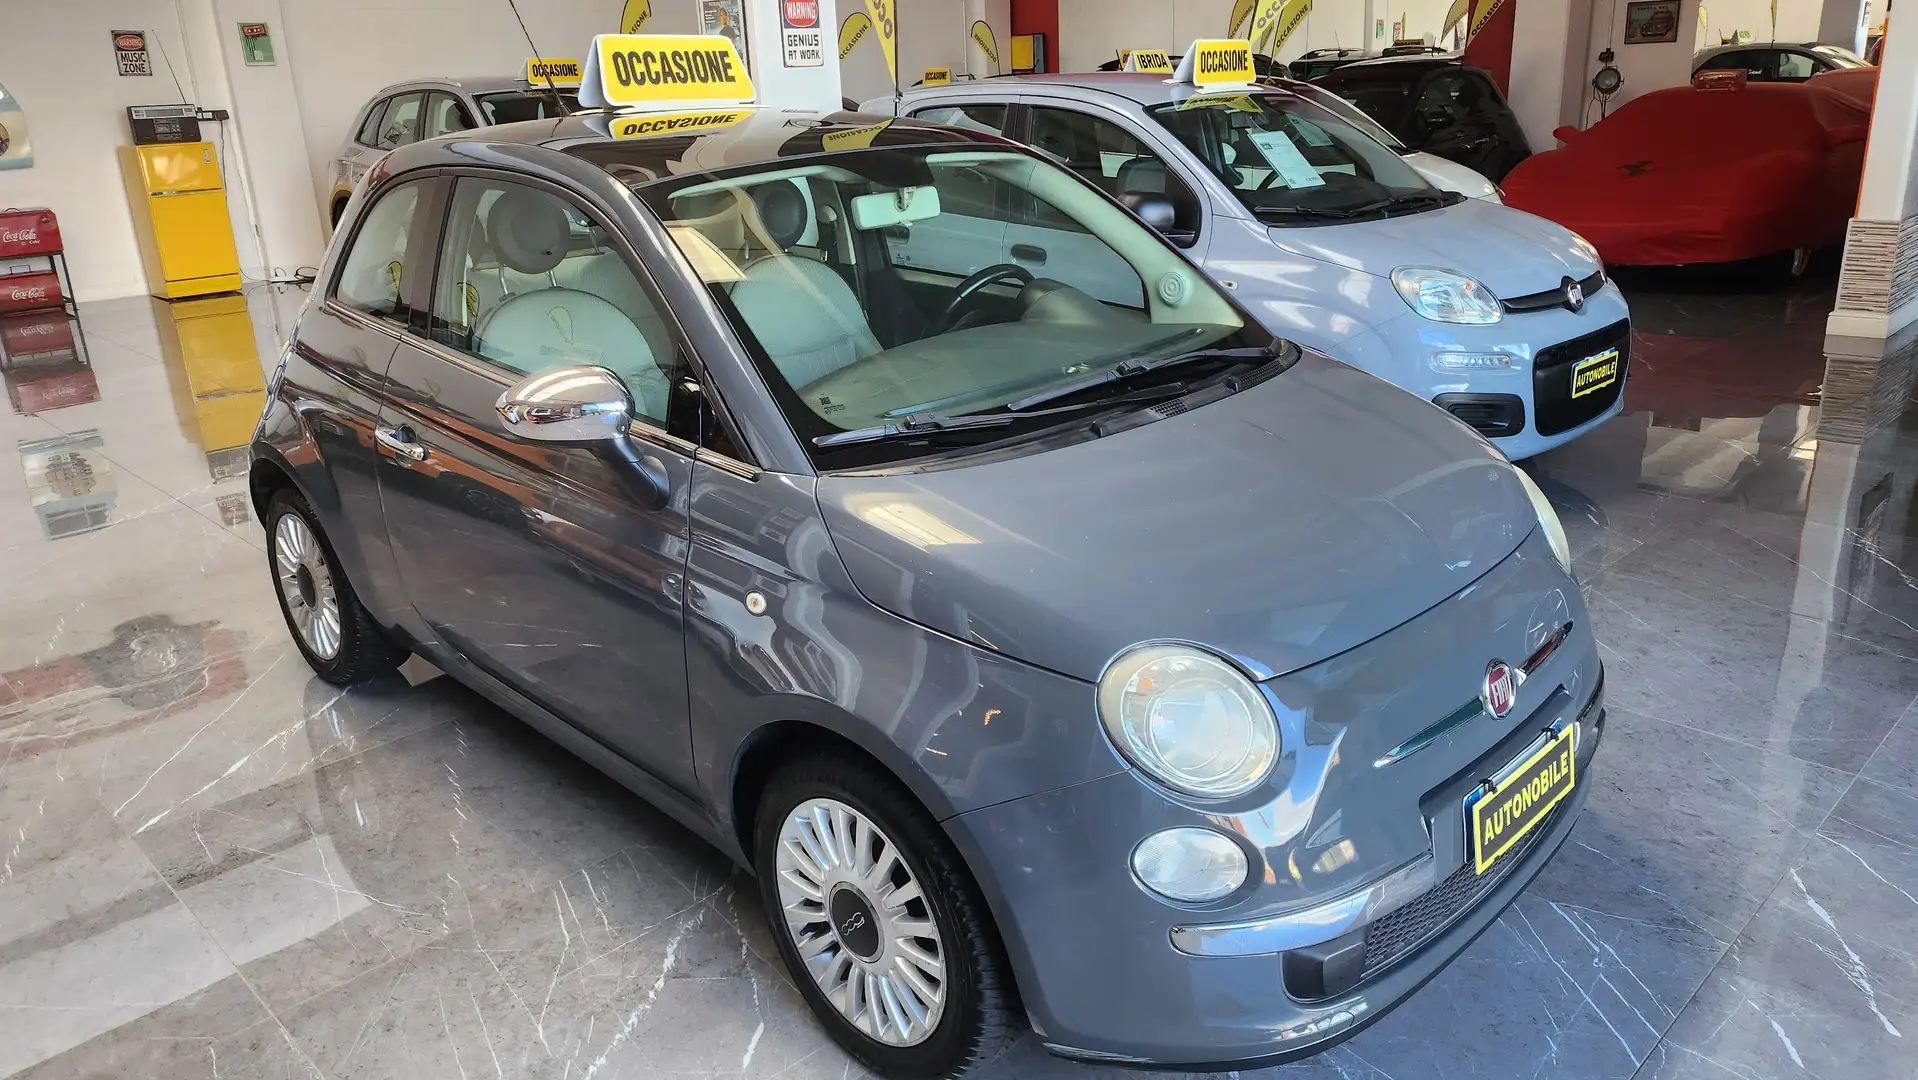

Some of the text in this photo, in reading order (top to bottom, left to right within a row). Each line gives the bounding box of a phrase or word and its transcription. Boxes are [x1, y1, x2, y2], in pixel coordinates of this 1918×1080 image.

[786, 1, 816, 20] WARNING
[1276, 4, 1309, 48] OCCASIONE
[787, 34, 819, 47] GENIUS
[839, 23, 869, 60] OCCASIONE
[120, 52, 146, 62] MUSIC
[788, 49, 821, 60] AT WORK
[1136, 53, 1169, 69] IBRIDA
[1200, 49, 1249, 73] OCCASIONE
[123, 63, 146, 73] ZONE
[532, 63, 579, 78] OCCASIONE
[611, 50, 736, 87] OCCASIONE
[1490, 669, 1512, 708] FIAT
[1484, 749, 1569, 846] AUTONOBILE
